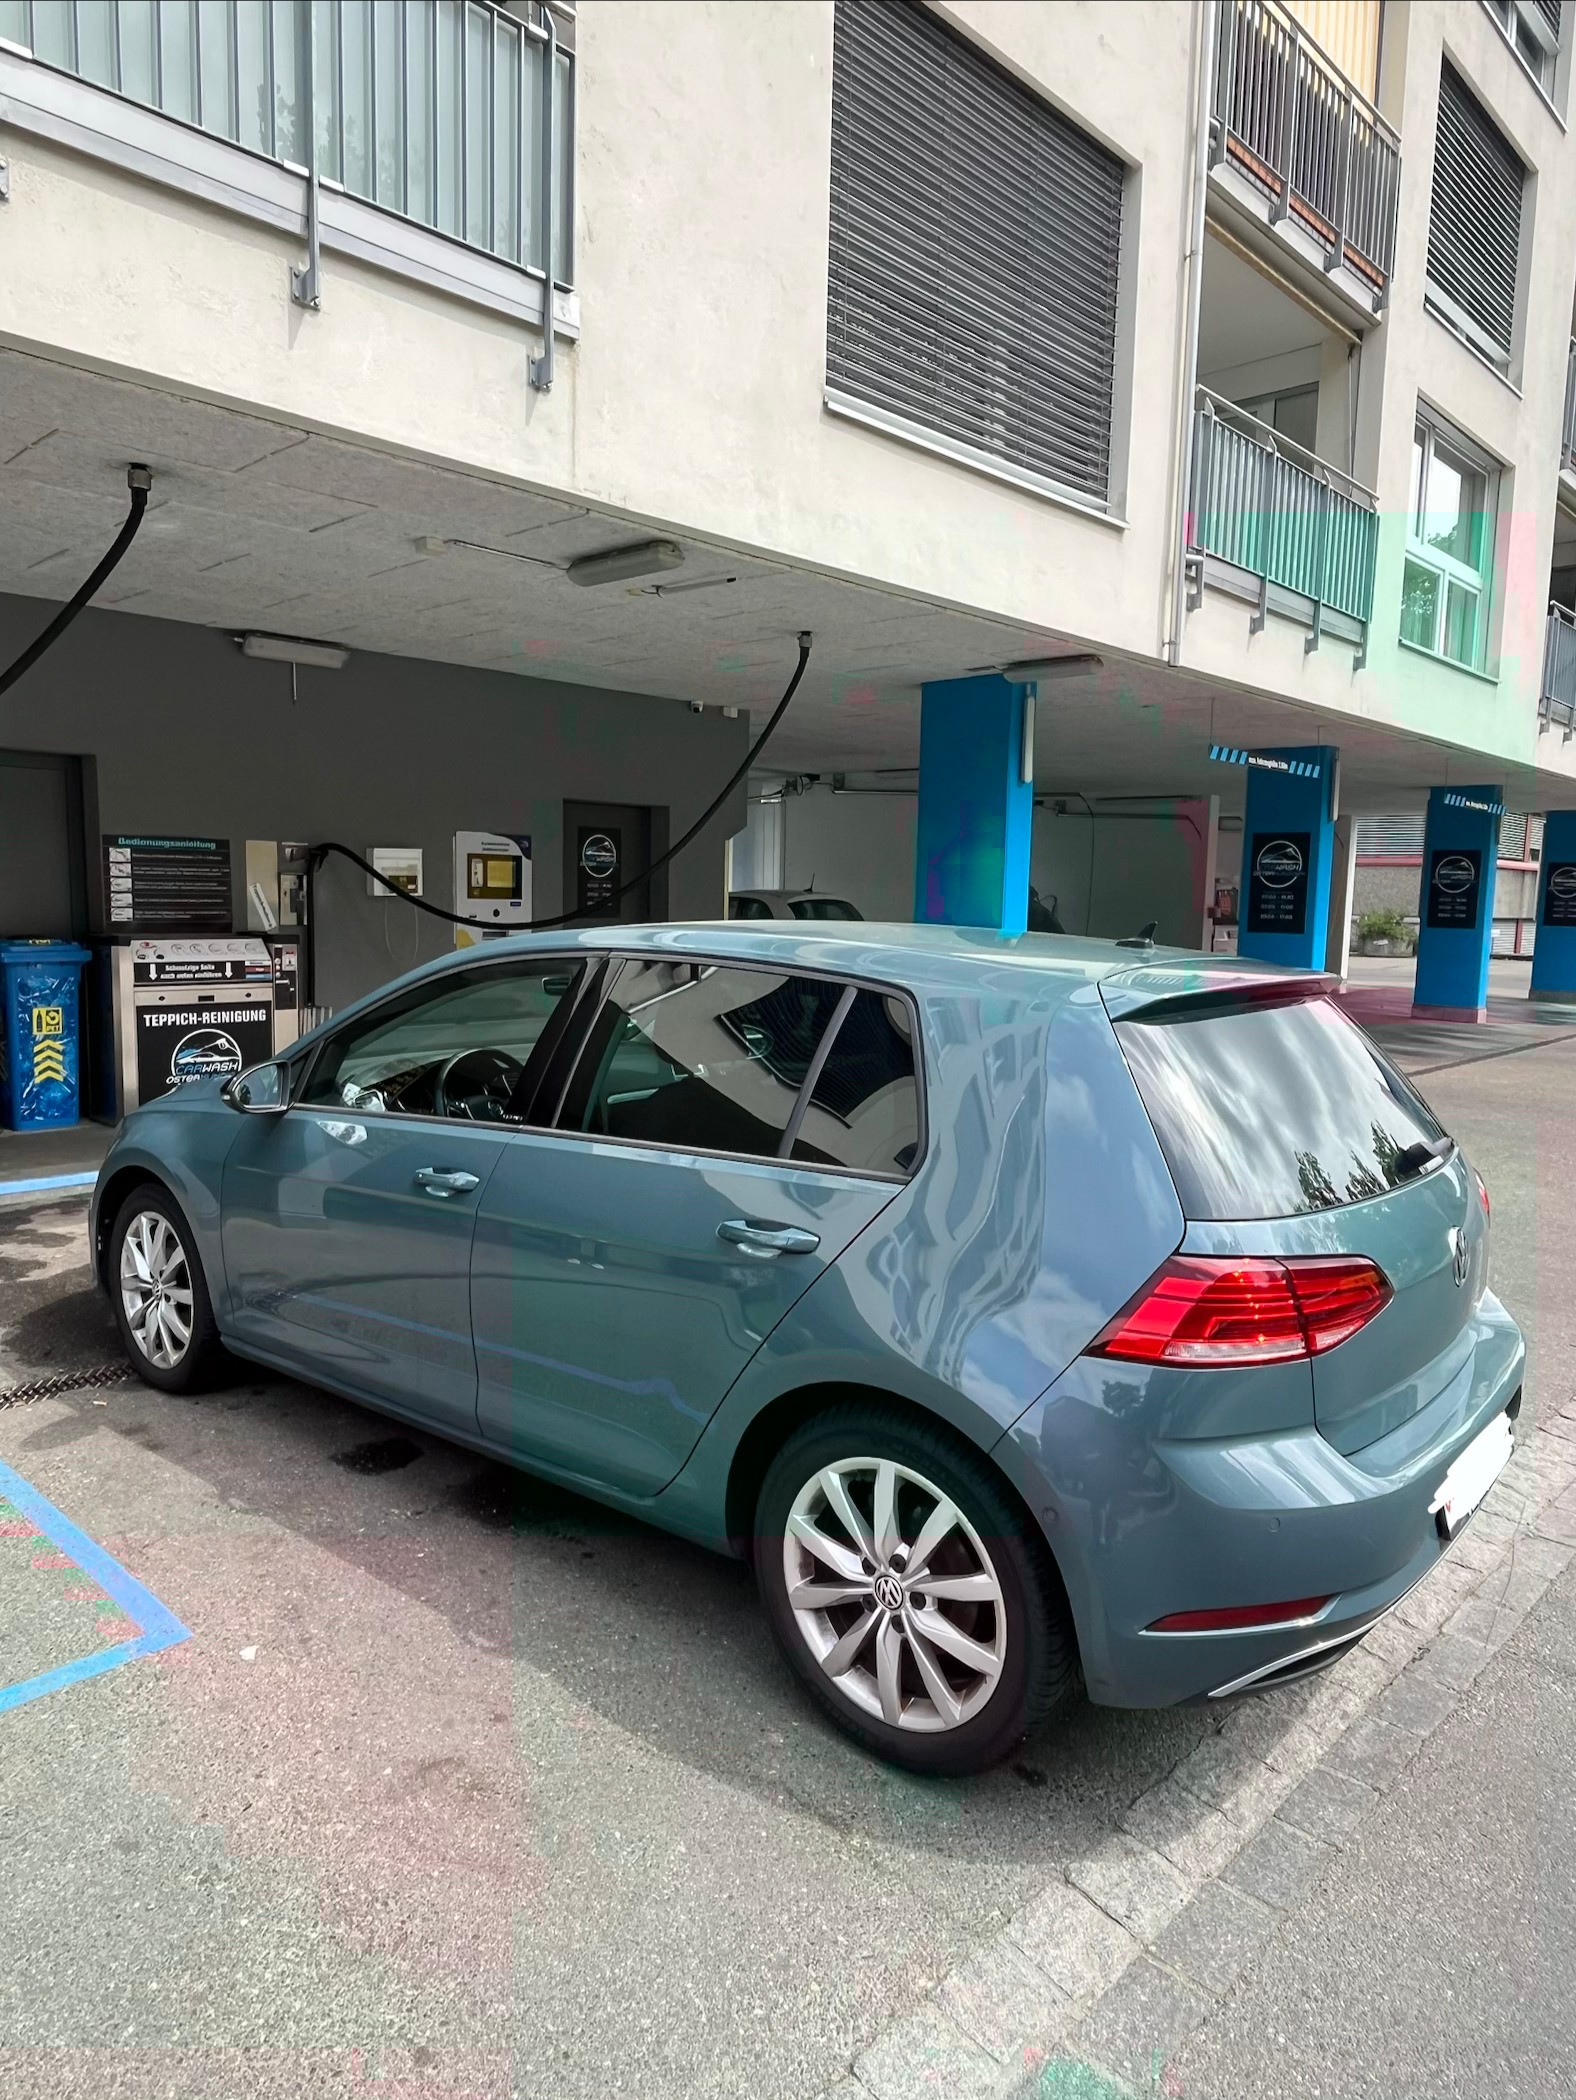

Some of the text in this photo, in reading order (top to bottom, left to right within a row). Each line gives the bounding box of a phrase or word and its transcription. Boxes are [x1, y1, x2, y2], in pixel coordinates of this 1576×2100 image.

[118, 837, 216, 850] Bedienungsanleitung
[143, 1009, 267, 1027] TEPPICH-REINIGUNG
[176, 1061, 238, 1075] CARWASH
[875, 1575, 903, 1610] VW
